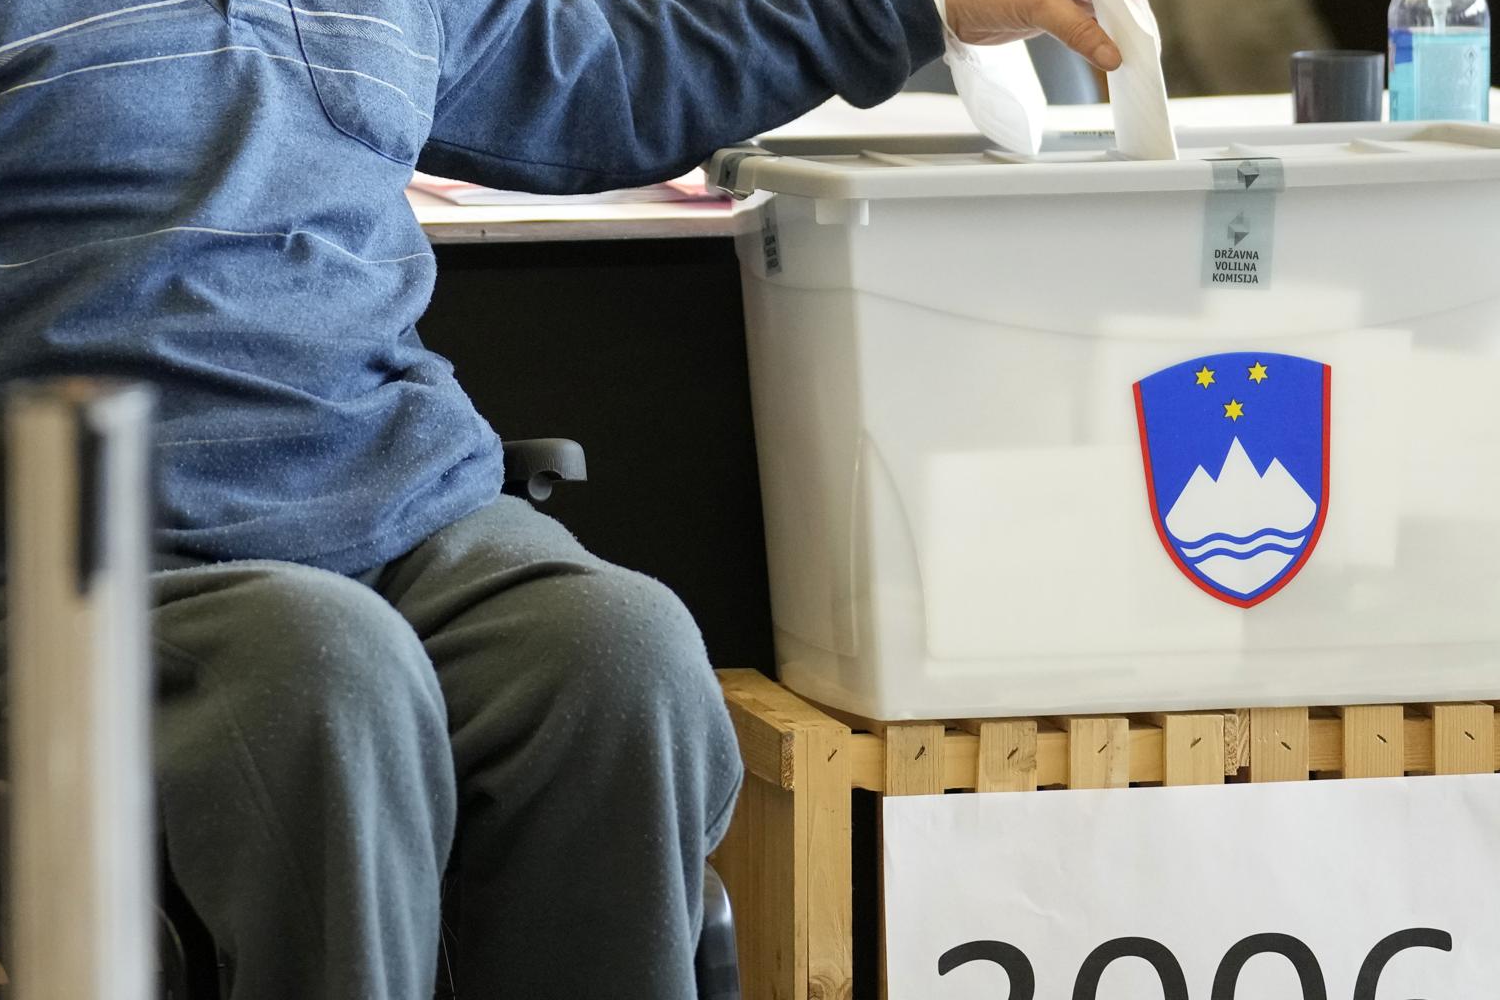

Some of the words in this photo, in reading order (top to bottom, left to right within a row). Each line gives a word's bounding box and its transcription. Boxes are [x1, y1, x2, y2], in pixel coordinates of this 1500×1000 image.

[1214, 248, 1259, 260] DRŽAVNA
[1215, 261, 1257, 272] VOLILNA
[1212, 273, 1259, 284] KOMISIJA
